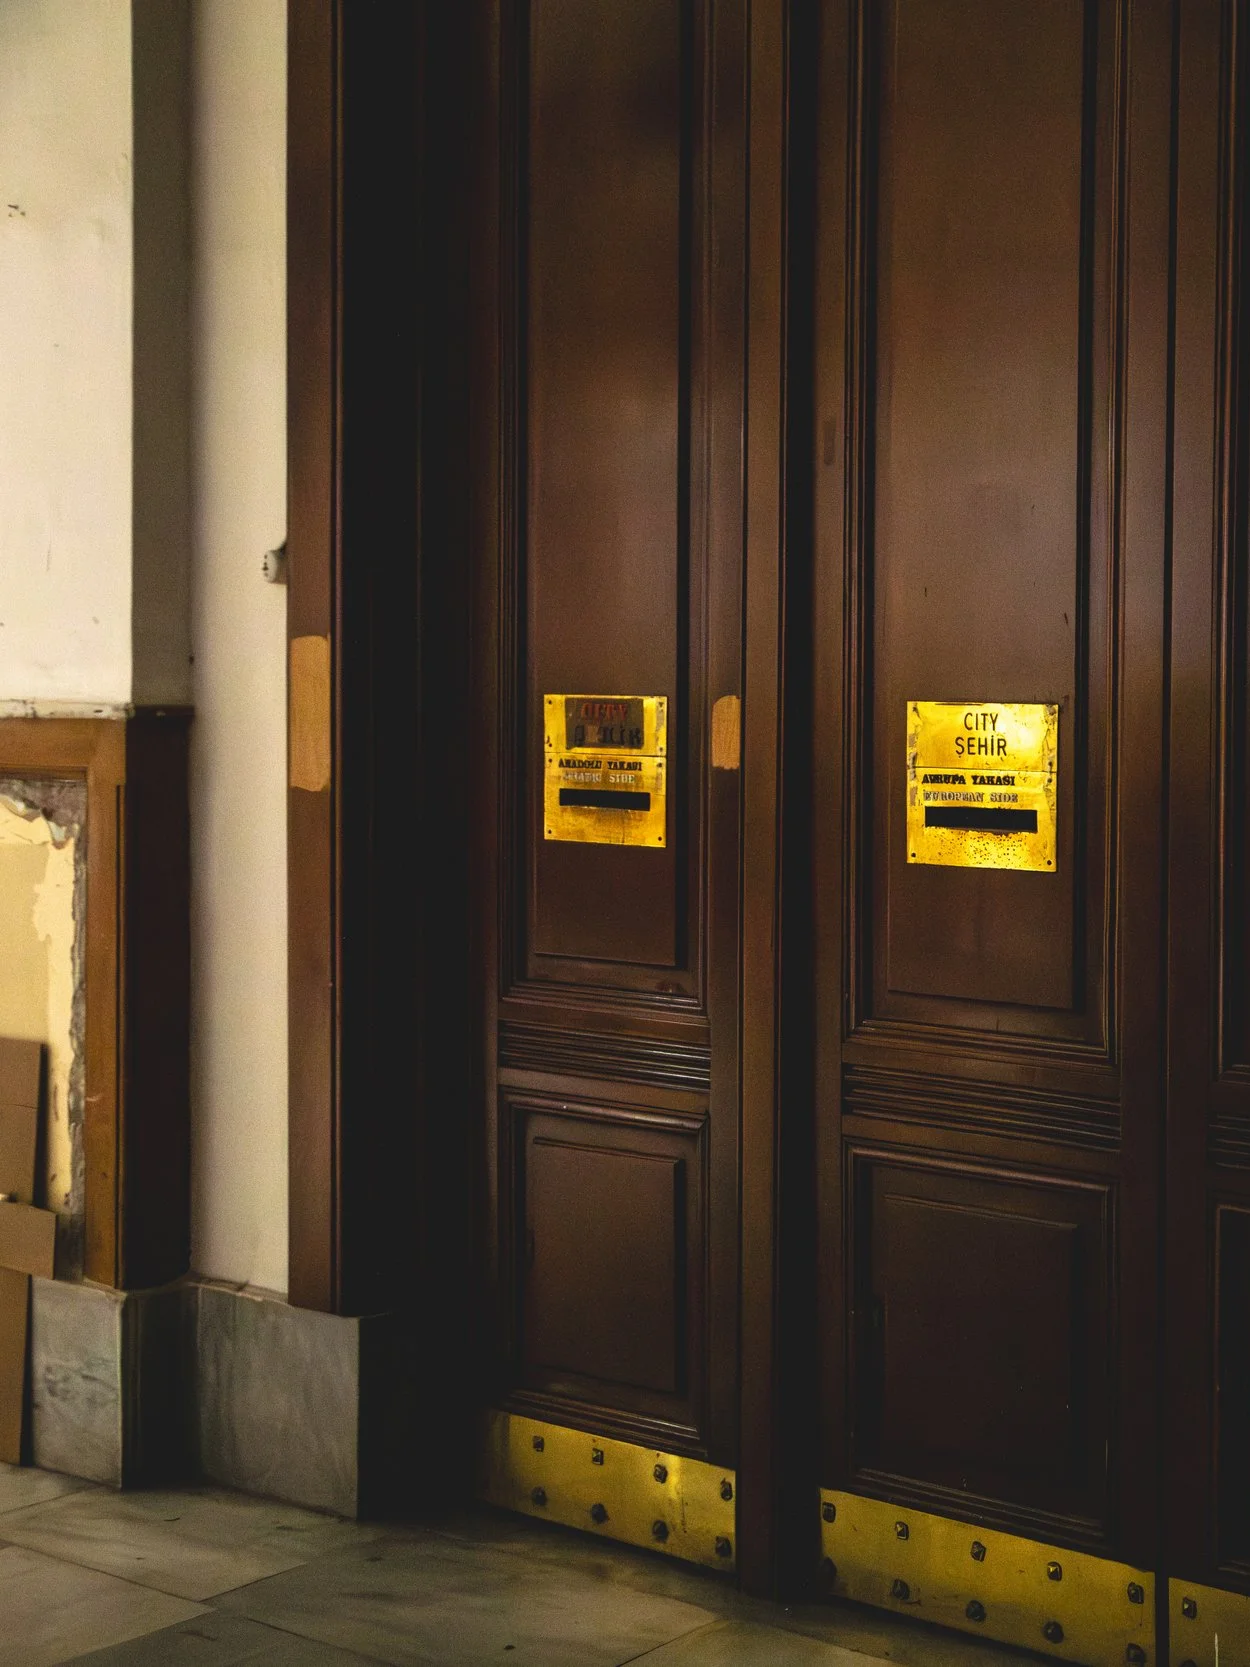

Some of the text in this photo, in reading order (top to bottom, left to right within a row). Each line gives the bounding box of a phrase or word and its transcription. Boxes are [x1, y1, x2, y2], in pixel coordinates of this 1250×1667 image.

[963, 712, 999, 732] CITY
[955, 735, 1008, 759] ŞEHİR
[609, 773, 635, 784] SIDE
[921, 773, 1015, 786] AVRUPA YAKASI
[923, 790, 1019, 803] EUROPEAN SIDE
